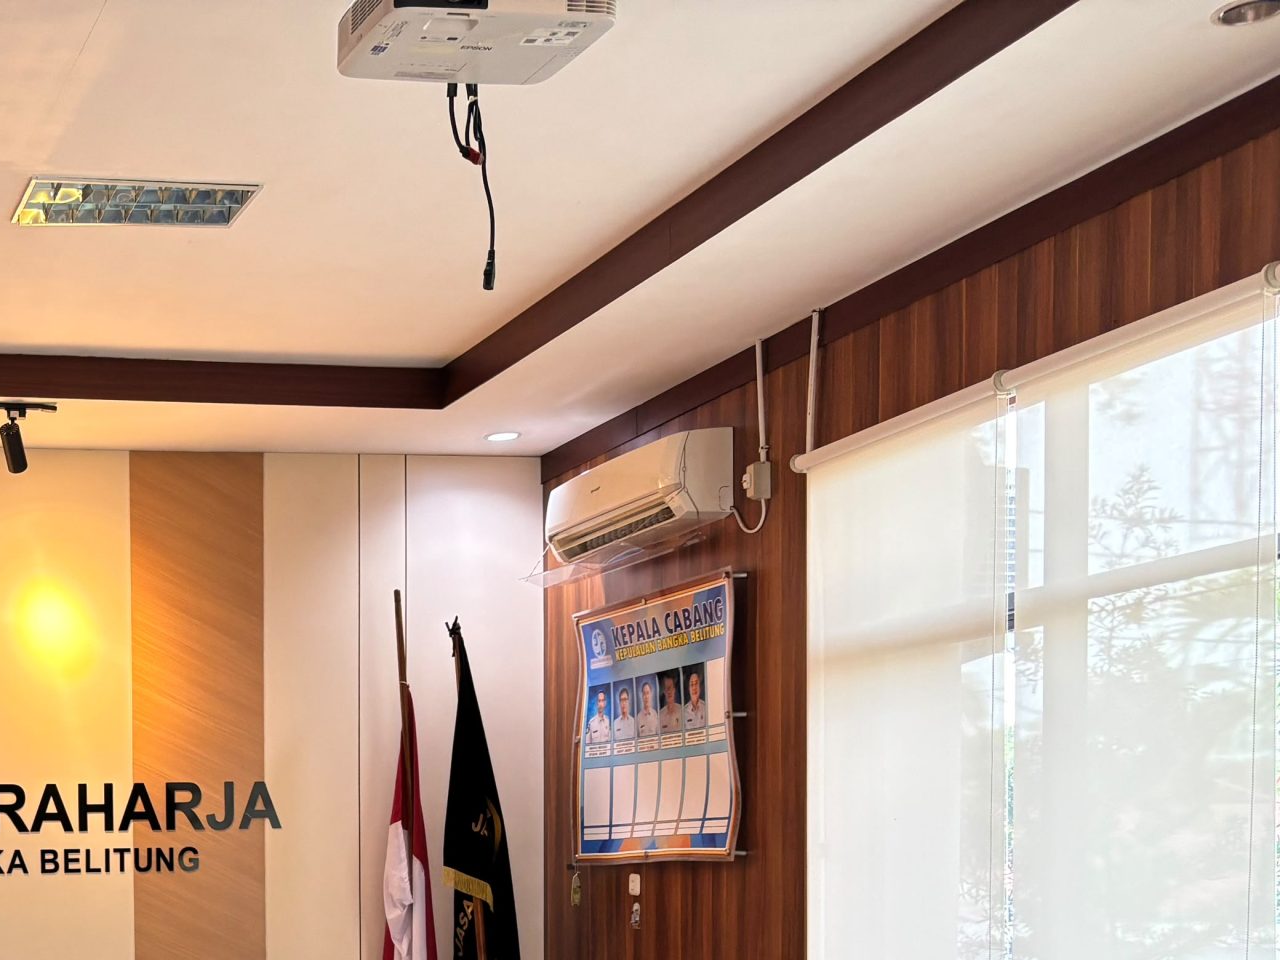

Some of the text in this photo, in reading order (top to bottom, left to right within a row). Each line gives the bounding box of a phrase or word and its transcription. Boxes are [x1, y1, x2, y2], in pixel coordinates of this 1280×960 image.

[611, 597, 724, 648] KEPALA CABANG
[615, 622, 725, 662] KEPULAUAN BANGKA BELITUNG
[39, 845, 201, 875] BELITUNG
